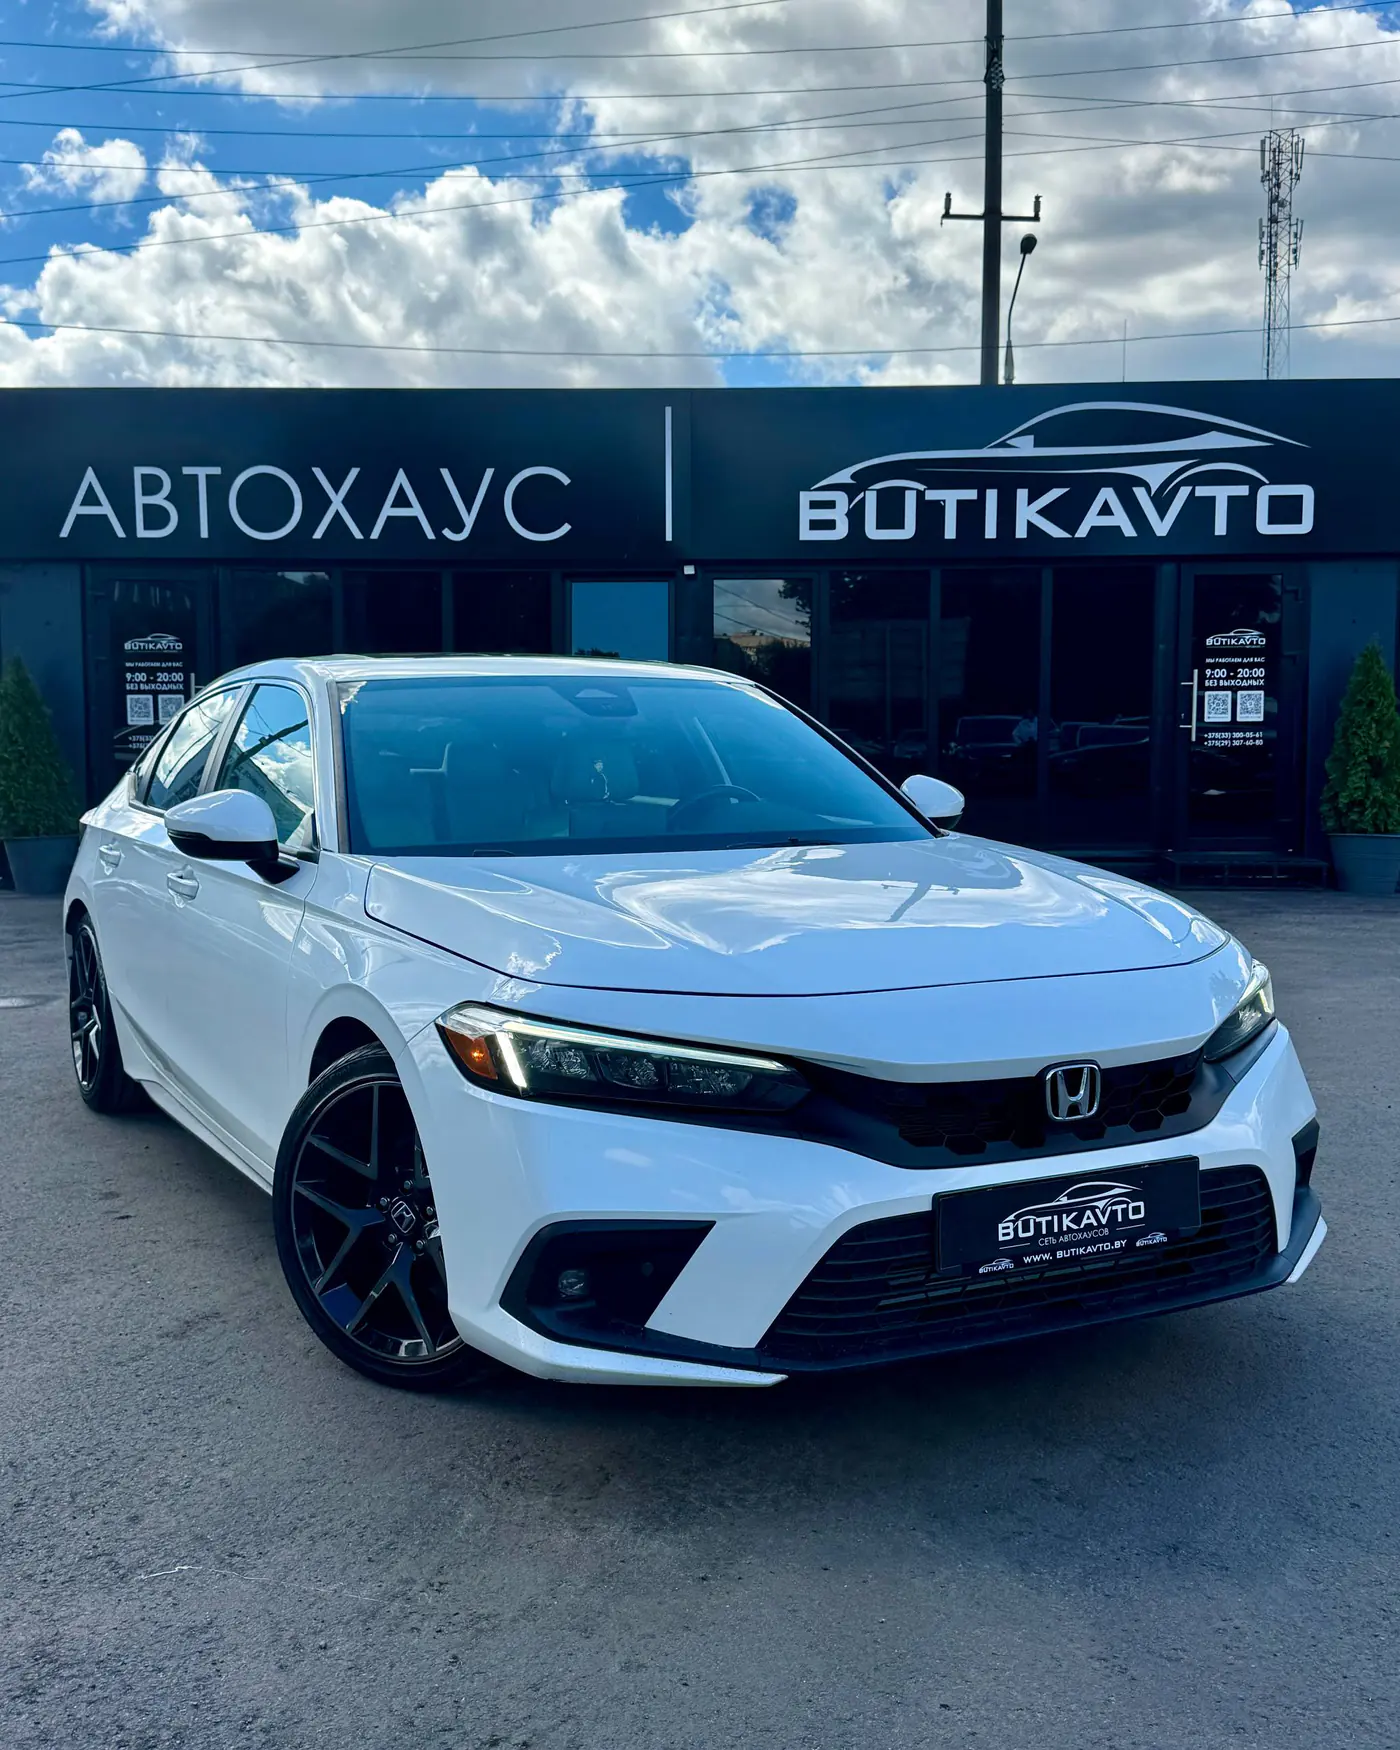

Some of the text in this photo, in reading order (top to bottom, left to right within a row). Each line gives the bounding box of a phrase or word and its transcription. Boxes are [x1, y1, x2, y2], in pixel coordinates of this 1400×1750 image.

[59, 465, 572, 542] АВТОХАУС
[799, 484, 1315, 541] BUTIKAVTO
[1206, 638, 1266, 646] BUTIKAVTO
[126, 673, 147, 682] 9:00
[156, 672, 184, 682] 20:00
[1205, 669, 1227, 678] 9:00
[1236, 668, 1265, 678] 20:00
[1219, 679, 1265, 687] ВЫХОДНЫХ
[998, 1201, 1145, 1241] BUTIKAVTO
[1038, 1228, 1109, 1247] СЕТЬ АВТОХАУСОВ
[1136, 1236, 1167, 1247] BUTIKAVTO
[1023, 1239, 1128, 1264] WWW. BUTIKAVTO.BY
[979, 1263, 1014, 1274] BUTIKAVTO
